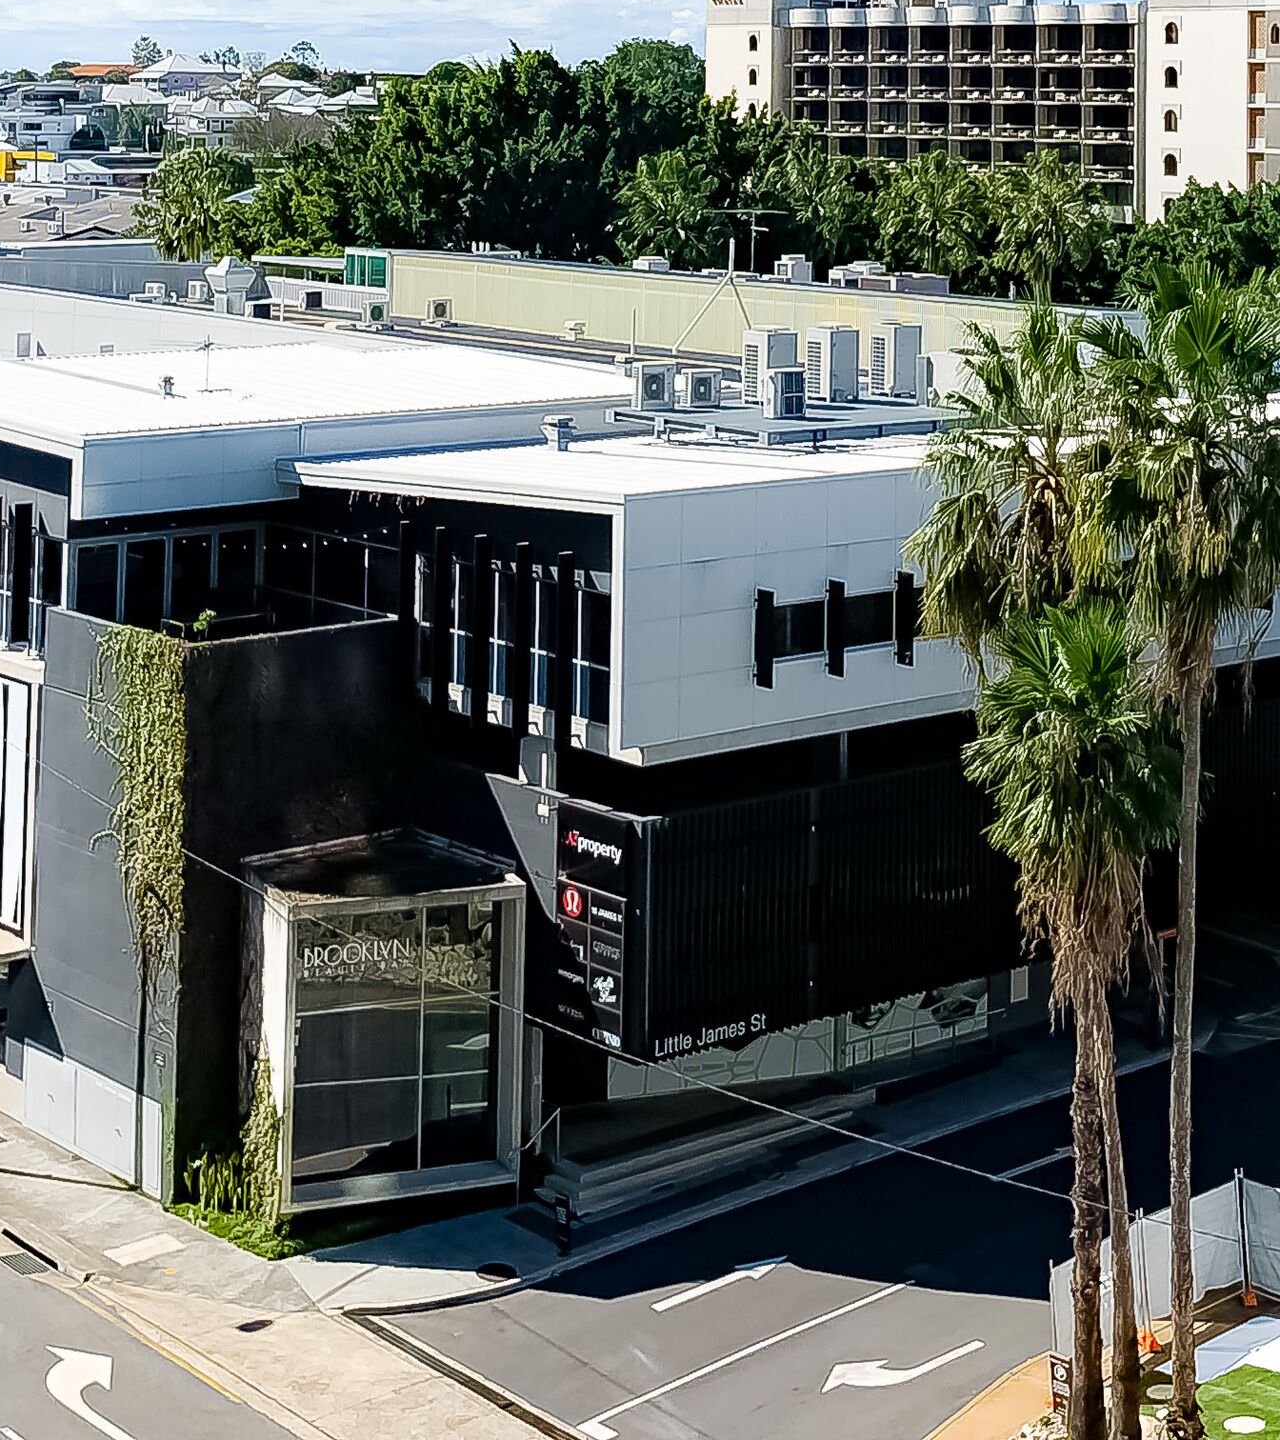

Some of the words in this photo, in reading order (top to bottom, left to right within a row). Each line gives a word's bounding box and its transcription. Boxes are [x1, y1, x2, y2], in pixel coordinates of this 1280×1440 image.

[577, 836, 623, 866] property
[304, 938, 409, 968] BROOKLYN
[654, 1033, 692, 1057] Little
[696, 1021, 746, 1046] James
[750, 1013, 767, 1032] St
